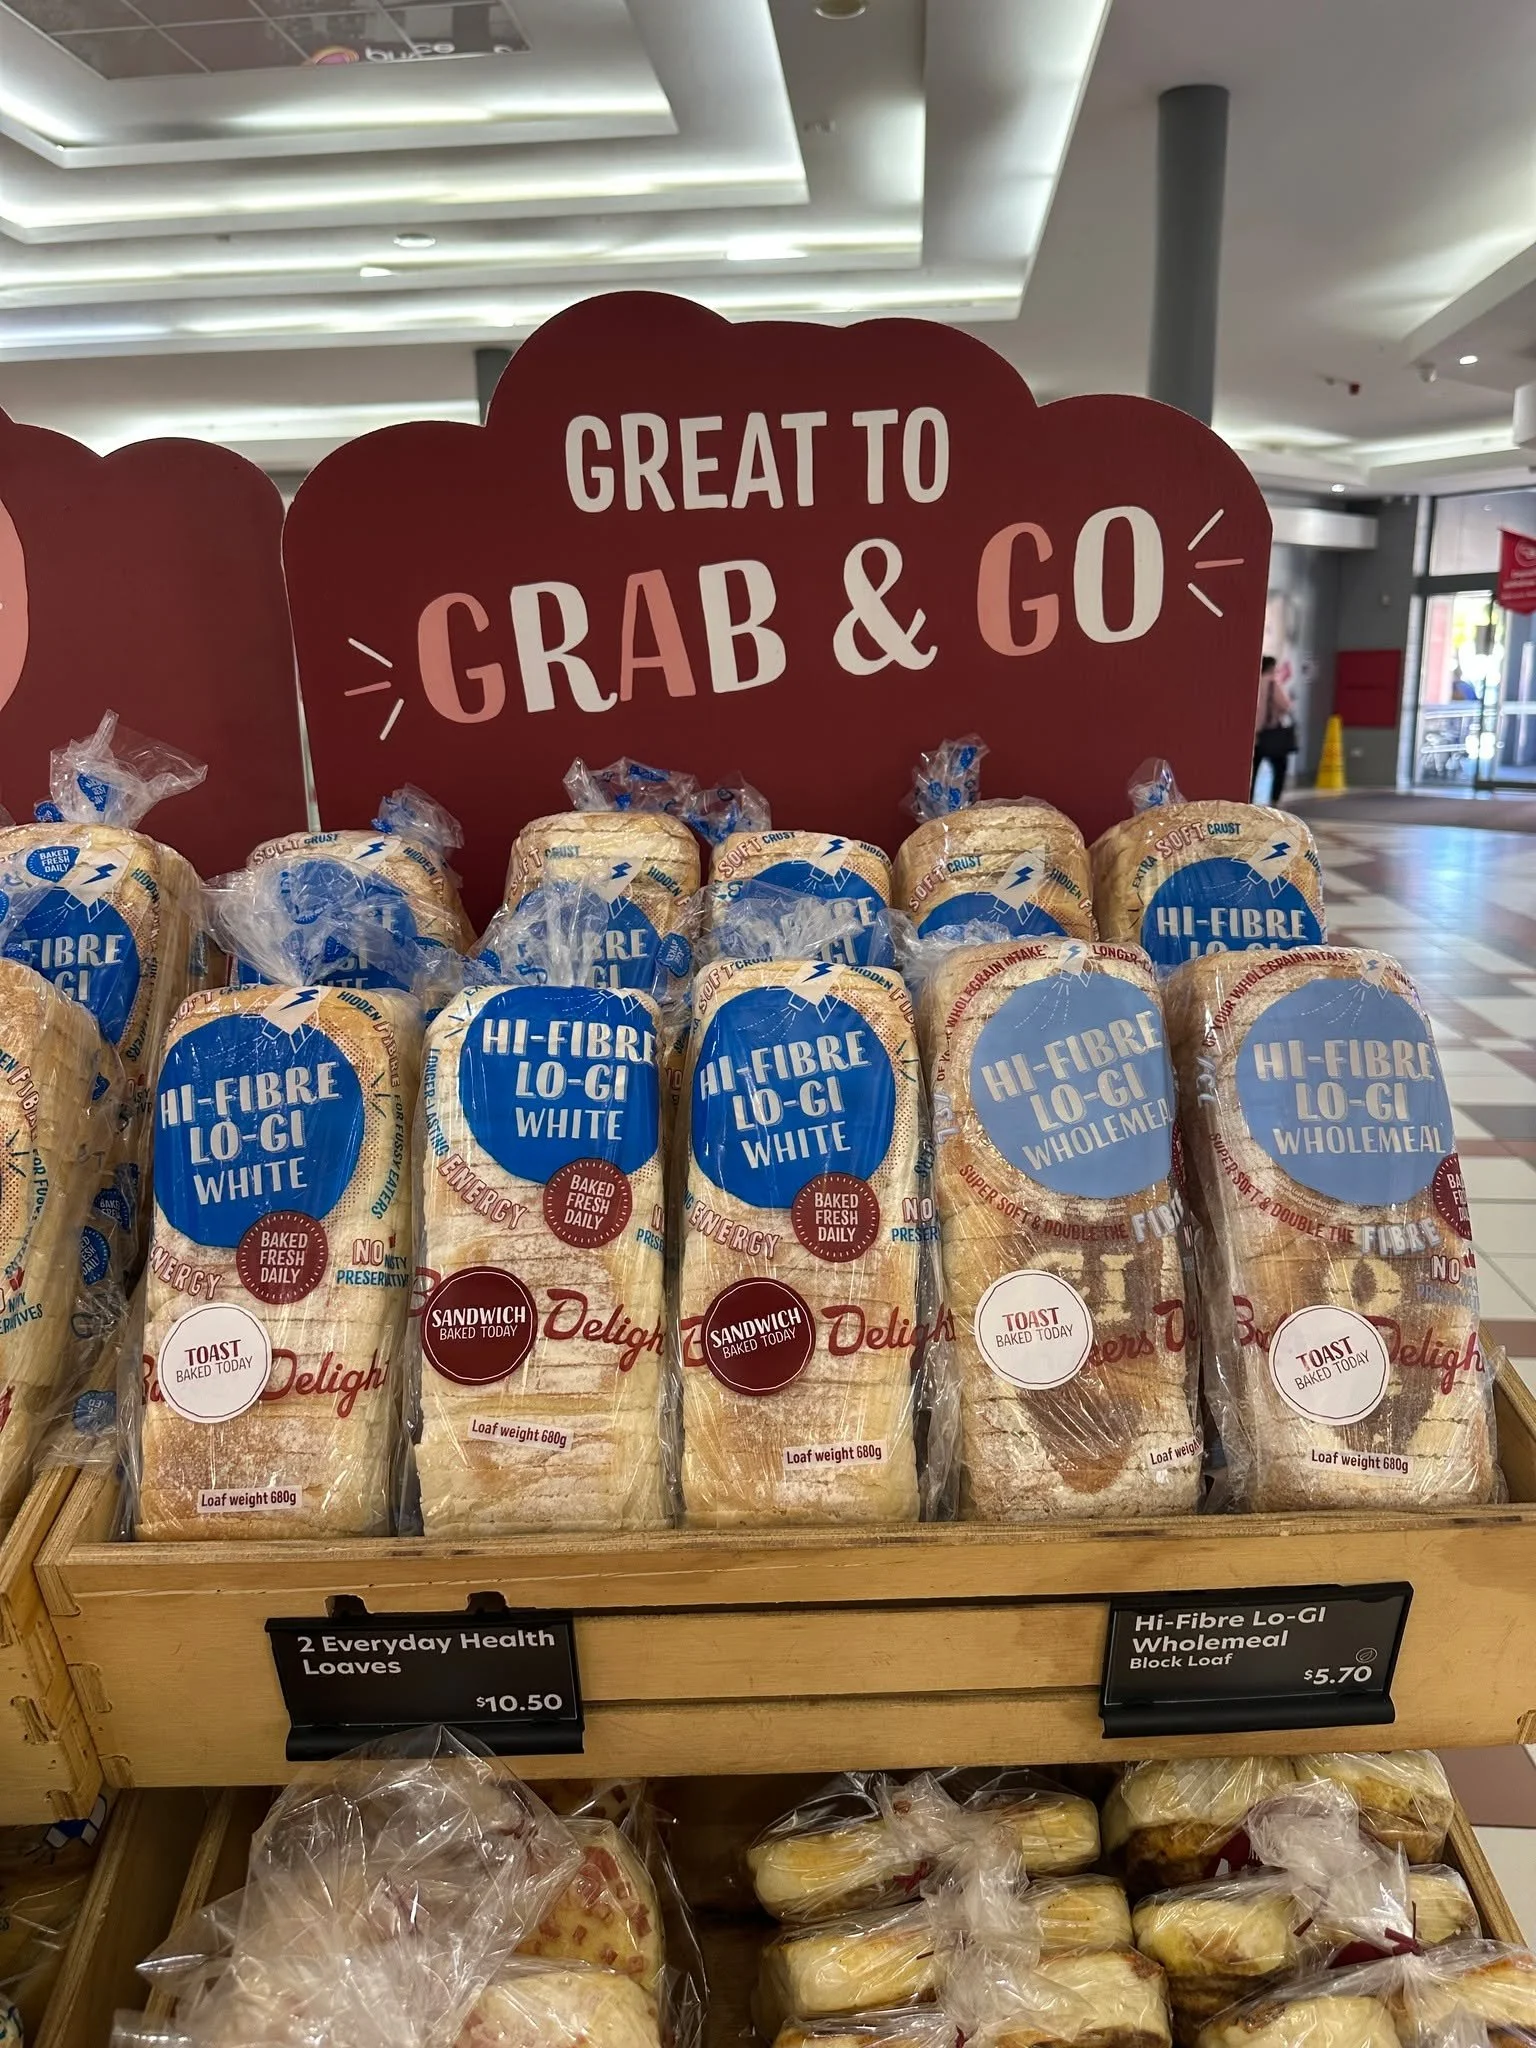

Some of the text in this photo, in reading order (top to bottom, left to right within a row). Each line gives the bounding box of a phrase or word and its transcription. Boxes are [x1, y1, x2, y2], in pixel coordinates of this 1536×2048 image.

[565, 406, 951, 513] GREAT TO
[417, 505, 1165, 724] GRAB & GO
[39, 849, 69, 861] BAKED
[41, 856, 70, 868] FRESH
[44, 864, 70, 873] DAILY
[402, 846, 438, 877] HIDDEN
[718, 831, 796, 878] SOFT CRUST
[1132, 822, 1241, 889] EXTRA SOFT CRUST
[648, 866, 682, 897] HIDDEN
[908, 865, 946, 912] SOFT
[946, 855, 982, 874] CRUST
[1050, 868, 1082, 900] HIDDEN
[1156, 905, 1310, 941] HI-FIBRE
[699, 961, 735, 1012] SOFT
[948, 962, 1005, 1030] WHOLEGRAIN
[1213, 999, 1236, 1031] YOUR
[1229, 951, 1305, 1001] WHOLEGRAIN
[337, 990, 383, 1022] HIDDEN
[700, 1030, 872, 1100] HI-FIBRE
[980, 1010, 1163, 1102] HI-FIBRE
[1253, 1040, 1436, 1082] HI-FIBRE
[160, 1061, 343, 1130] HI-FIBRE
[515, 1060, 628, 1102] LO-GI
[394, 1094, 404, 1121] FOR
[732, 1076, 845, 1133] LO-GI
[1030, 1062, 1148, 1133] LO-GI
[1295, 1082, 1411, 1123] LO-GI
[189, 1110, 307, 1166] LO-GI
[515, 1106, 625, 1141] WHITE
[1022, 1097, 1173, 1171] WHOLEMEA
[392, 1124, 404, 1171] FUSSY
[741, 1121, 852, 1170] WHITE
[1272, 1125, 1447, 1155] WHOLEMEAL
[193, 1156, 308, 1206] WHITE
[371, 1169, 400, 1220] EATERS
[437, 1153, 528, 1230] ENERGY
[570, 1174, 615, 1199] BAKED
[1209, 1132, 1239, 1177] SUPER
[1232, 1172, 1263, 1203] SOFT
[1259, 1196, 1271, 1210] &
[1271, 1202, 1325, 1239] DOUBLE
[1328, 1225, 1354, 1244] THE
[1360, 1216, 1443, 1256] FIBRE
[566, 1194, 610, 1215] FRESH
[814, 1193, 859, 1209] BAKED
[902, 1197, 934, 1223] NO
[959, 1164, 998, 1209] SUPER
[995, 1196, 1034, 1227] SOFT
[1033, 1216, 1043, 1231] &
[1043, 1219, 1099, 1243] DOUBLE
[1102, 1223, 1130, 1241] THE
[563, 1207, 604, 1232] DAILY
[651, 1202, 665, 1235] N
[688, 1200, 781, 1260] ENERGY
[815, 1209, 859, 1226] FRESH
[261, 1230, 308, 1250] BAKED
[818, 1226, 857, 1243] DAILY
[259, 1249, 305, 1268] FRESH
[352, 1238, 384, 1266] NO
[150, 1242, 224, 1300] NERGY
[260, 1266, 301, 1286] DAILY
[1430, 1255, 1461, 1285] NO
[432, 1306, 527, 1328] SANDWICH
[439, 1324, 518, 1341] BAKED TODAY
[543, 1288, 665, 1373] Deligh
[710, 1306, 802, 1350] SANDWICH
[1002, 1306, 1060, 1333] TOAST
[723, 1327, 797, 1360] BAKED TODAY
[995, 1323, 1074, 1348] BAKED TODAY
[185, 1339, 242, 1367] TOAST
[1295, 1336, 1354, 1372] TOAST
[1364, 1315, 1485, 1395] Deligh
[175, 1355, 253, 1384] BAKED TODAY
[1294, 1349, 1371, 1391] BAKED TODAY
[472, 1418, 568, 1448] Loaf weight 680g
[786, 1443, 883, 1465] Loaf weight 680g
[1150, 1449, 1174, 1466] Loaf
[1311, 1449, 1409, 1474] Loaf weight 680g
[201, 1490, 297, 1508] Loaf weight 680g
[1135, 1606, 1327, 1632] Hi-Fibre Lo-GI
[297, 1629, 556, 1655] 2 Everyday Health
[1132, 1630, 1289, 1654] Wholemeal
[303, 1658, 402, 1676] Loaves
[1129, 1653, 1234, 1670] Block Loaf
[1303, 1665, 1373, 1686] $5.70
[476, 1693, 564, 1713] $10.50
